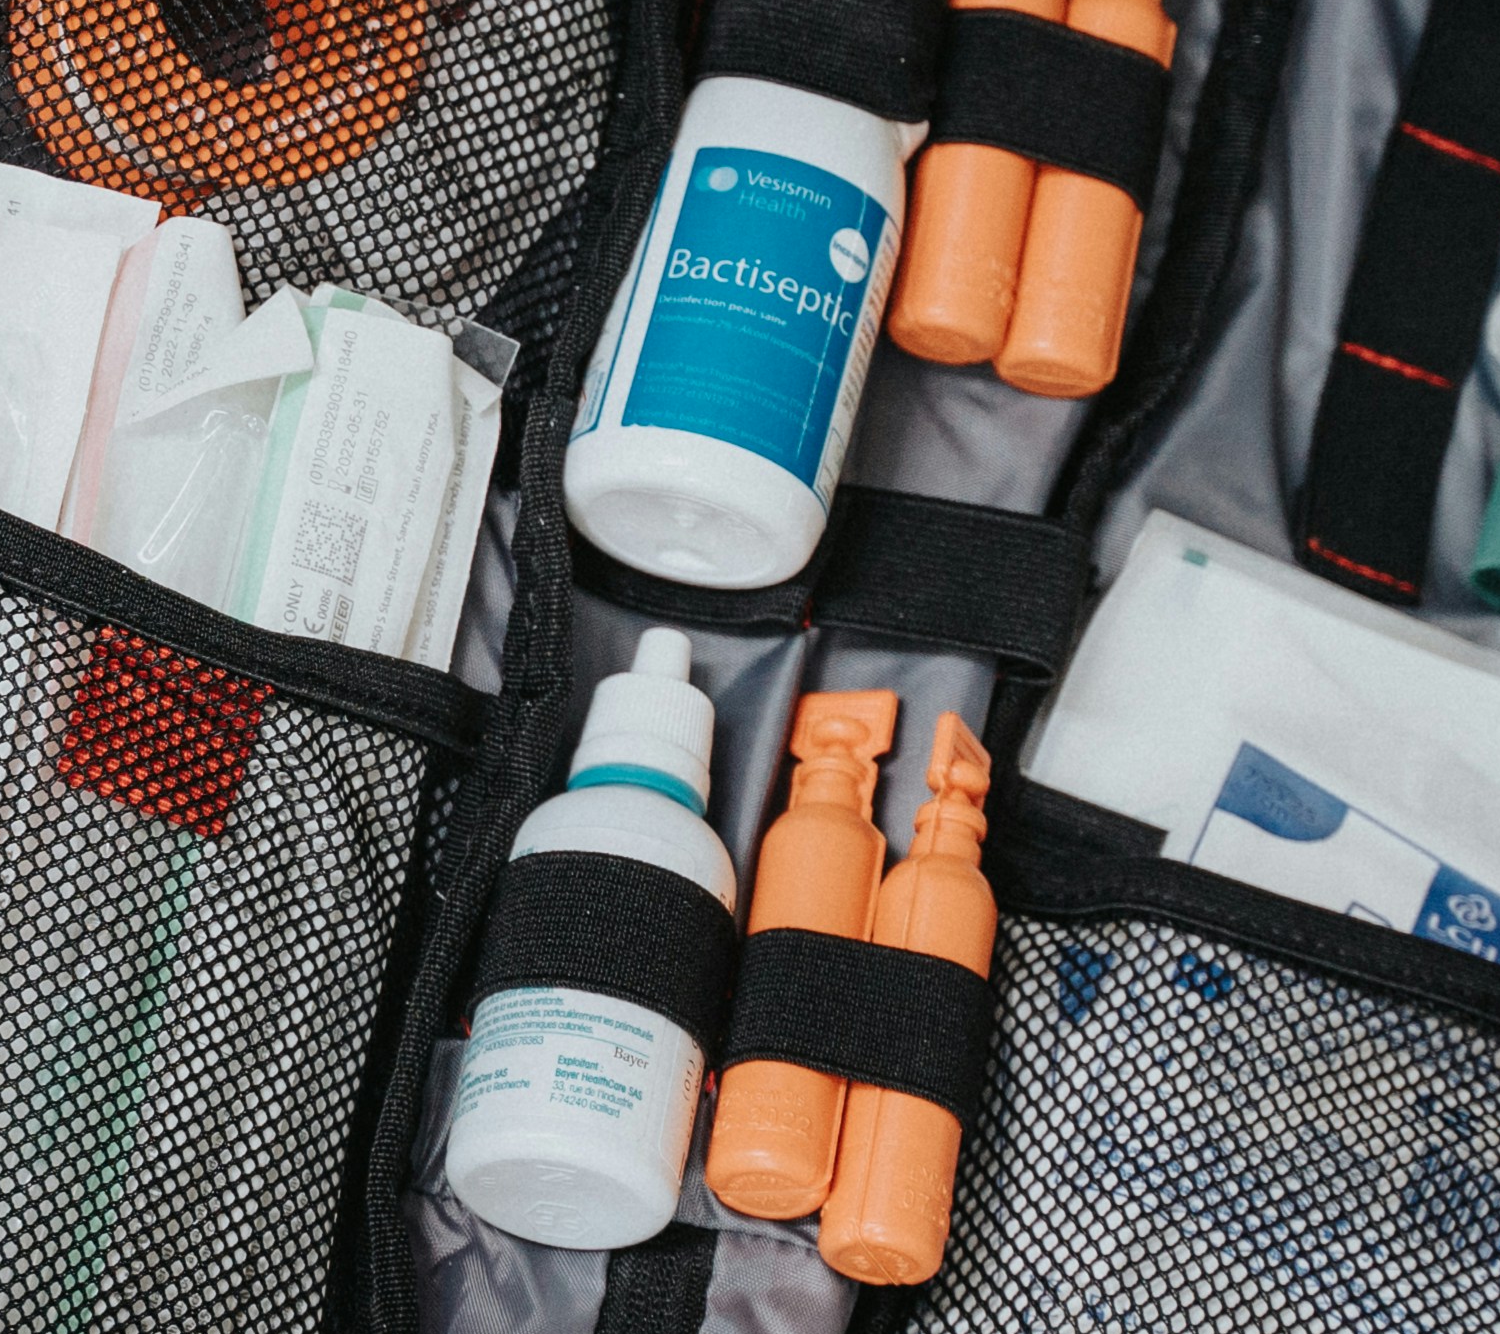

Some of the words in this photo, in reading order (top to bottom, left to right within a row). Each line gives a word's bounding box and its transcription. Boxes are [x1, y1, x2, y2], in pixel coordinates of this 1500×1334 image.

[738, 190, 807, 221] Health
[747, 169, 832, 210] Vesismin
[138, 233, 194, 393] (01)00382903818341
[667, 247, 854, 338] Bactiseptic
[727, 302, 757, 316] peau
[160, 292, 199, 379] 2022-11-30
[309, 330, 359, 486] (01)00382903818440
[334, 390, 369, 477] 2022-05-31
[361, 409, 391, 476] 9155752
[386, 546, 405, 582] Street,
[407, 476, 422, 504] Utah
[415, 437, 433, 474] 84070
[428, 556, 446, 588] State
[449, 447, 470, 477] Utah
[282, 578, 304, 623] ONLY
[317, 589, 333, 620] 0086
[336, 599, 350, 620] EO
[557, 1054, 600, 1071] Exploitant
[613, 1043, 649, 1069] Bayer
[551, 1079, 566, 1092] 33,
[569, 1084, 583, 1094] rue
[584, 1087, 595, 1096] de
[554, 1067, 579, 1080] Bayer
[581, 1073, 627, 1094] HealthCare
[628, 1086, 643, 1101] SAS
[549, 1092, 588, 1109] F-74240
[589, 1102, 621, 1119] Gaillard
